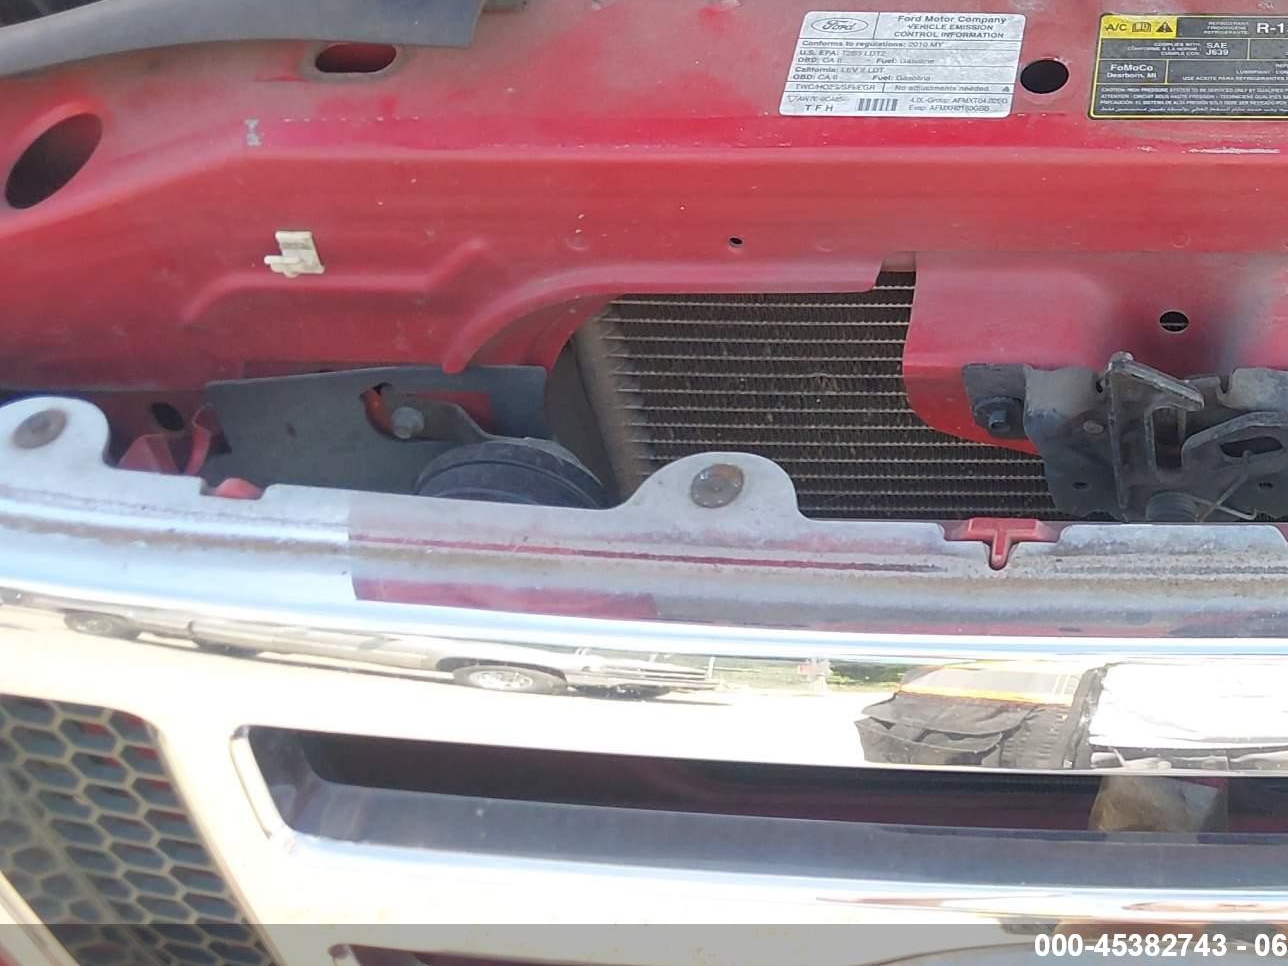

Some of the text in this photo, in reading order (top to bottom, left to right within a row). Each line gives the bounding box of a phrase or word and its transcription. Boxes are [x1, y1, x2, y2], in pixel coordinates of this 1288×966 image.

[925, 15, 954, 23] Motor
[958, 16, 1007, 24] Company
[822, 20, 856, 30] Ford
[1104, 23, 1128, 32] A/C
[856, 41, 906, 49] regulations:
